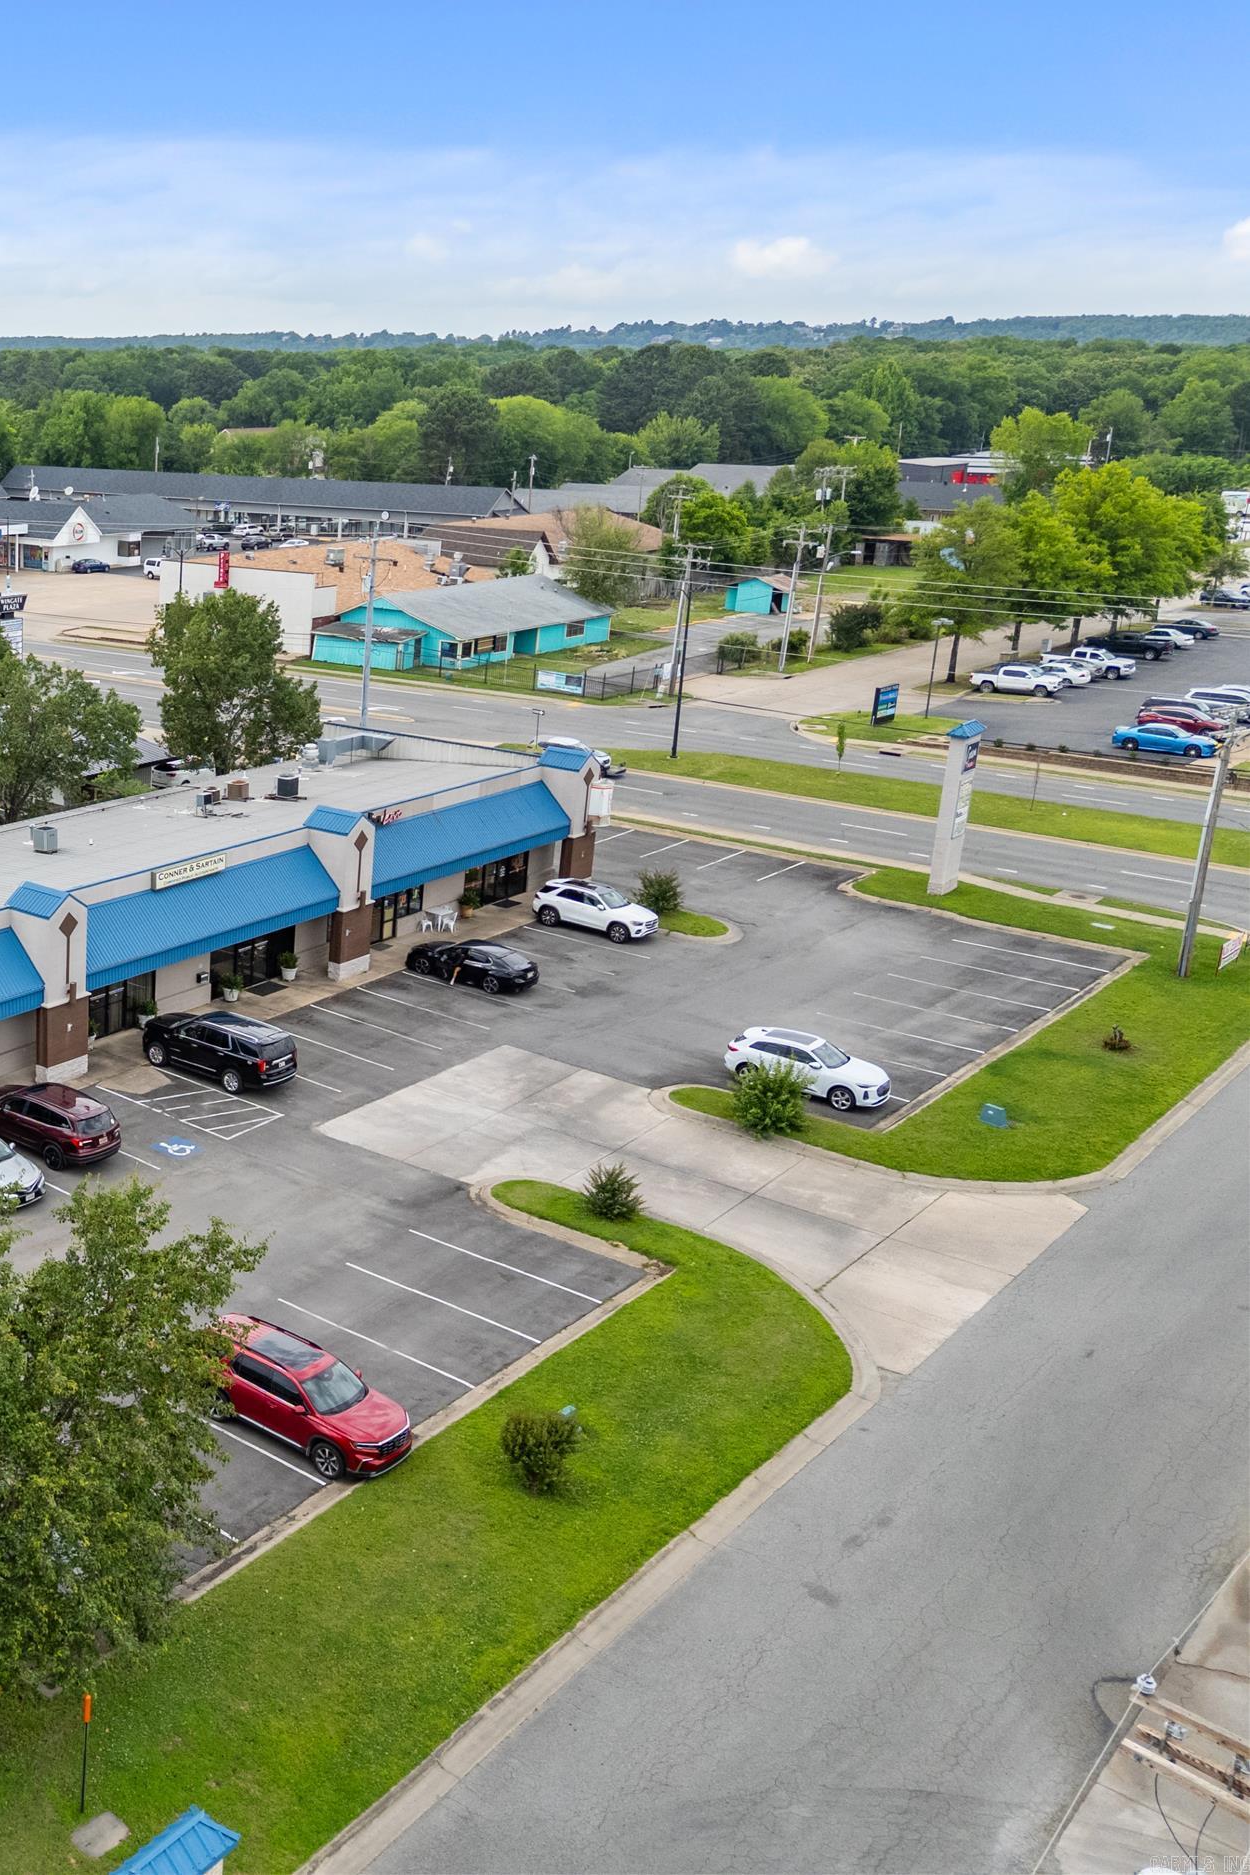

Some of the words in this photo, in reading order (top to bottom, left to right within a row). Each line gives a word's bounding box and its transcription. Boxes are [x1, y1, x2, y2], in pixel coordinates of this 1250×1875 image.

[3, 603, 20, 611] PLAZA
[158, 868, 188, 880] CONNER
[189, 864, 195, 872] &
[195, 857, 224, 869] SARTAIN
